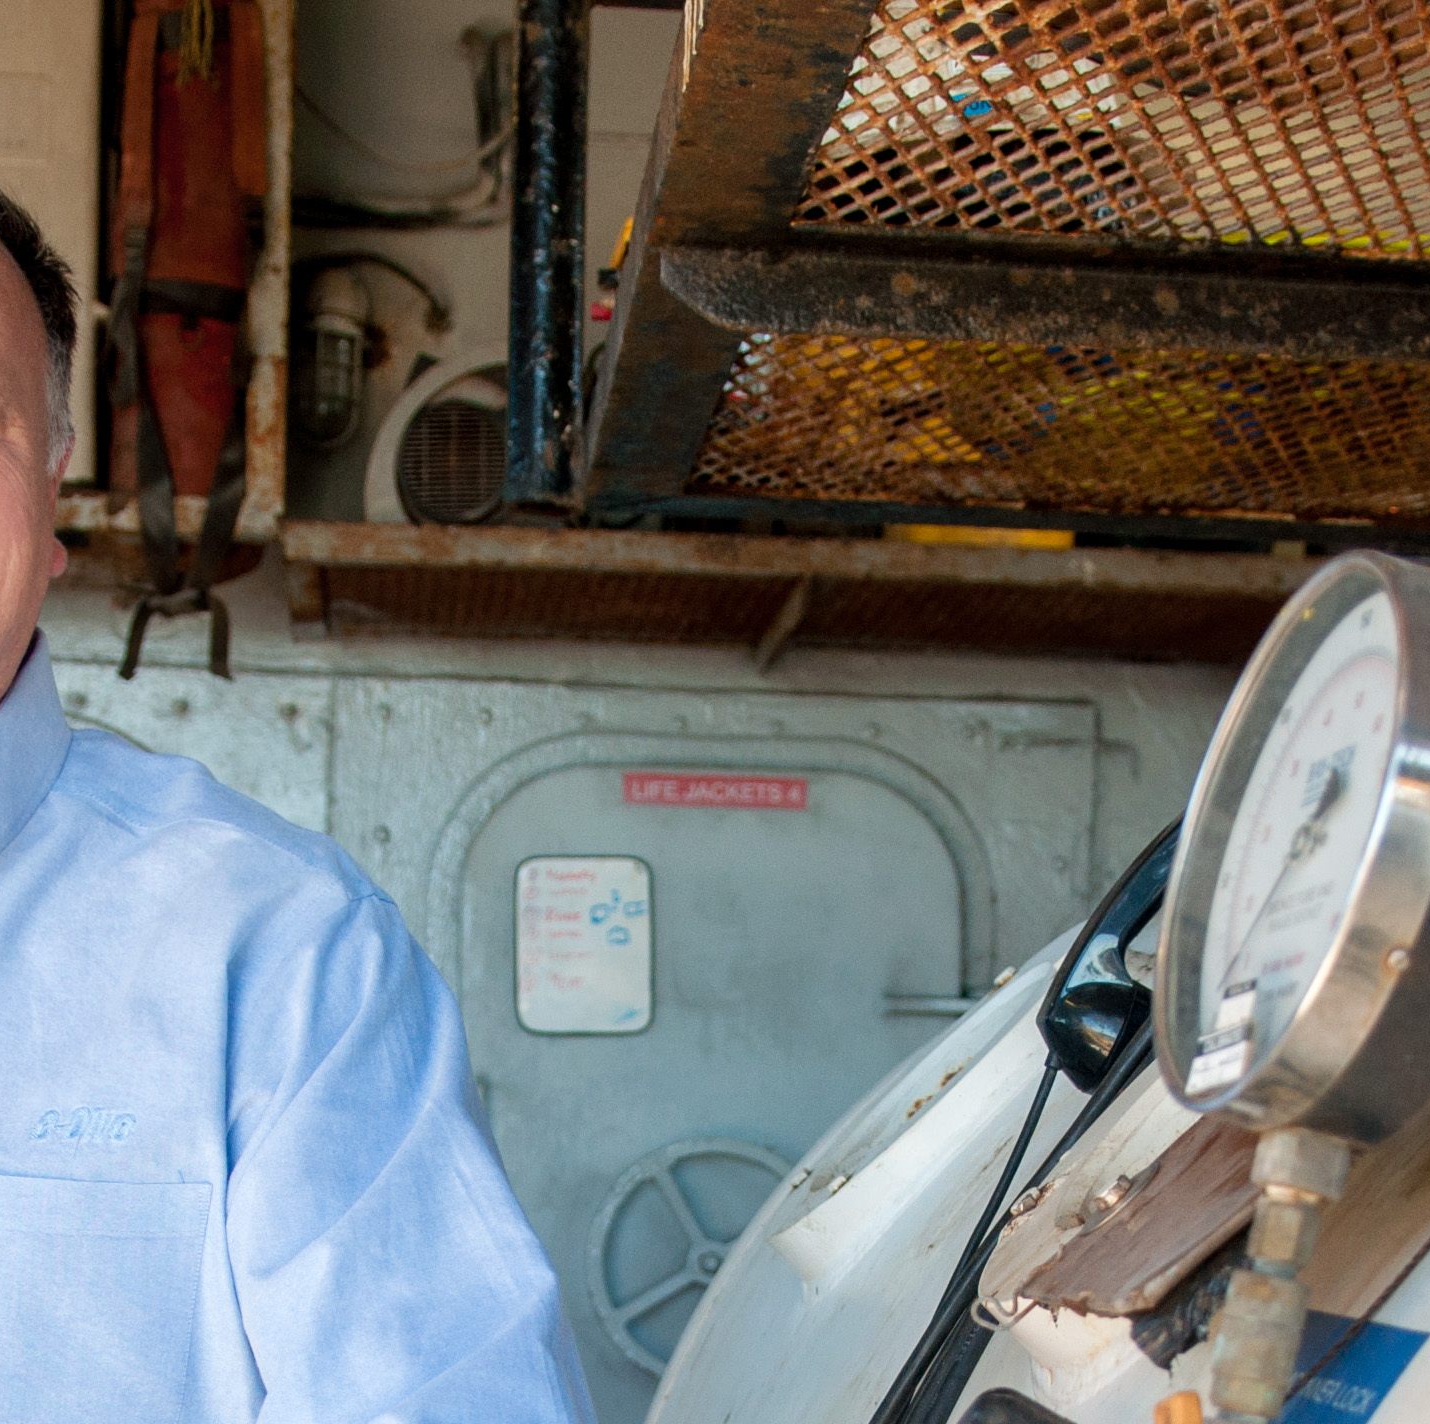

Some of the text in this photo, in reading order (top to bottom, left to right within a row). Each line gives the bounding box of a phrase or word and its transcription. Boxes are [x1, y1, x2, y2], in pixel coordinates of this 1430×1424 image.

[632, 779, 680, 802] LIFE
[685, 781, 783, 804] JACKETS
[1332, 1382, 1379, 1417] LOCK
